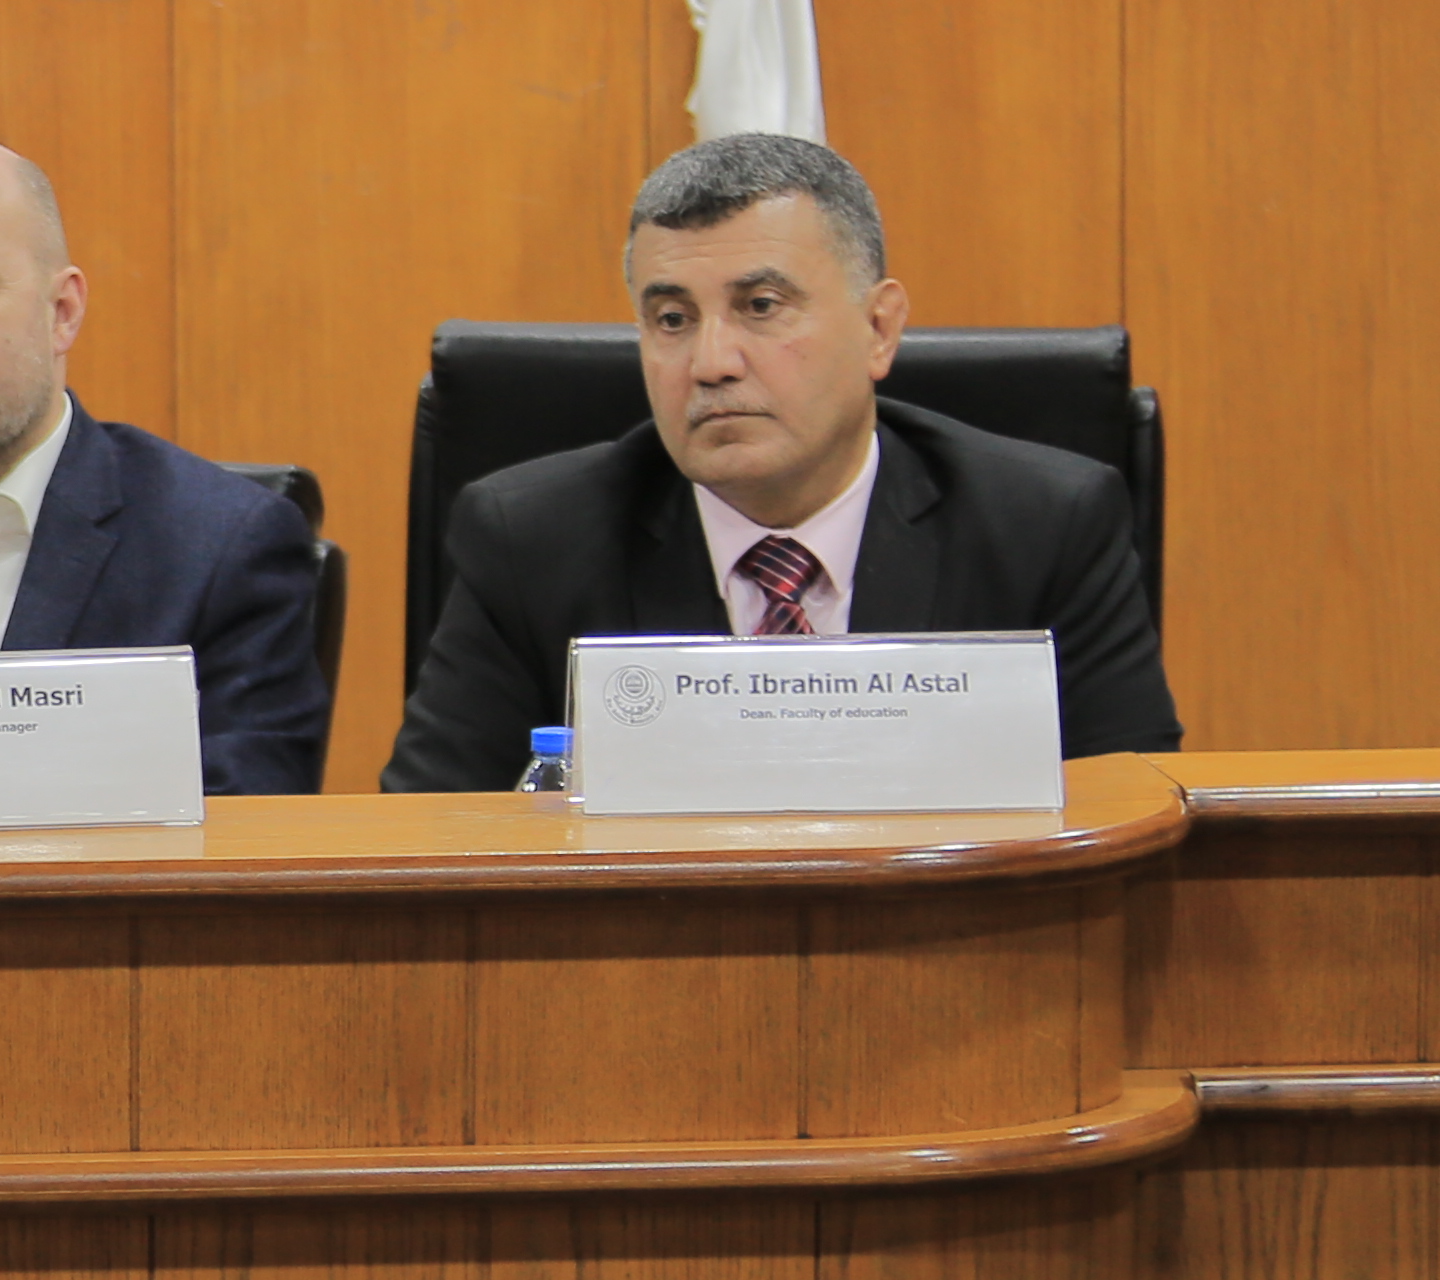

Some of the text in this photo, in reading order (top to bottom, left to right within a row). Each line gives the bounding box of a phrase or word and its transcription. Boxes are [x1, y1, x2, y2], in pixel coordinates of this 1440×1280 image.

[676, 672, 968, 695] Prof. Ibrahim Al Astal
[10, 684, 83, 707] Masri
[779, 708, 827, 721] Faculty
[828, 707, 844, 721] of
[845, 707, 908, 718] education
